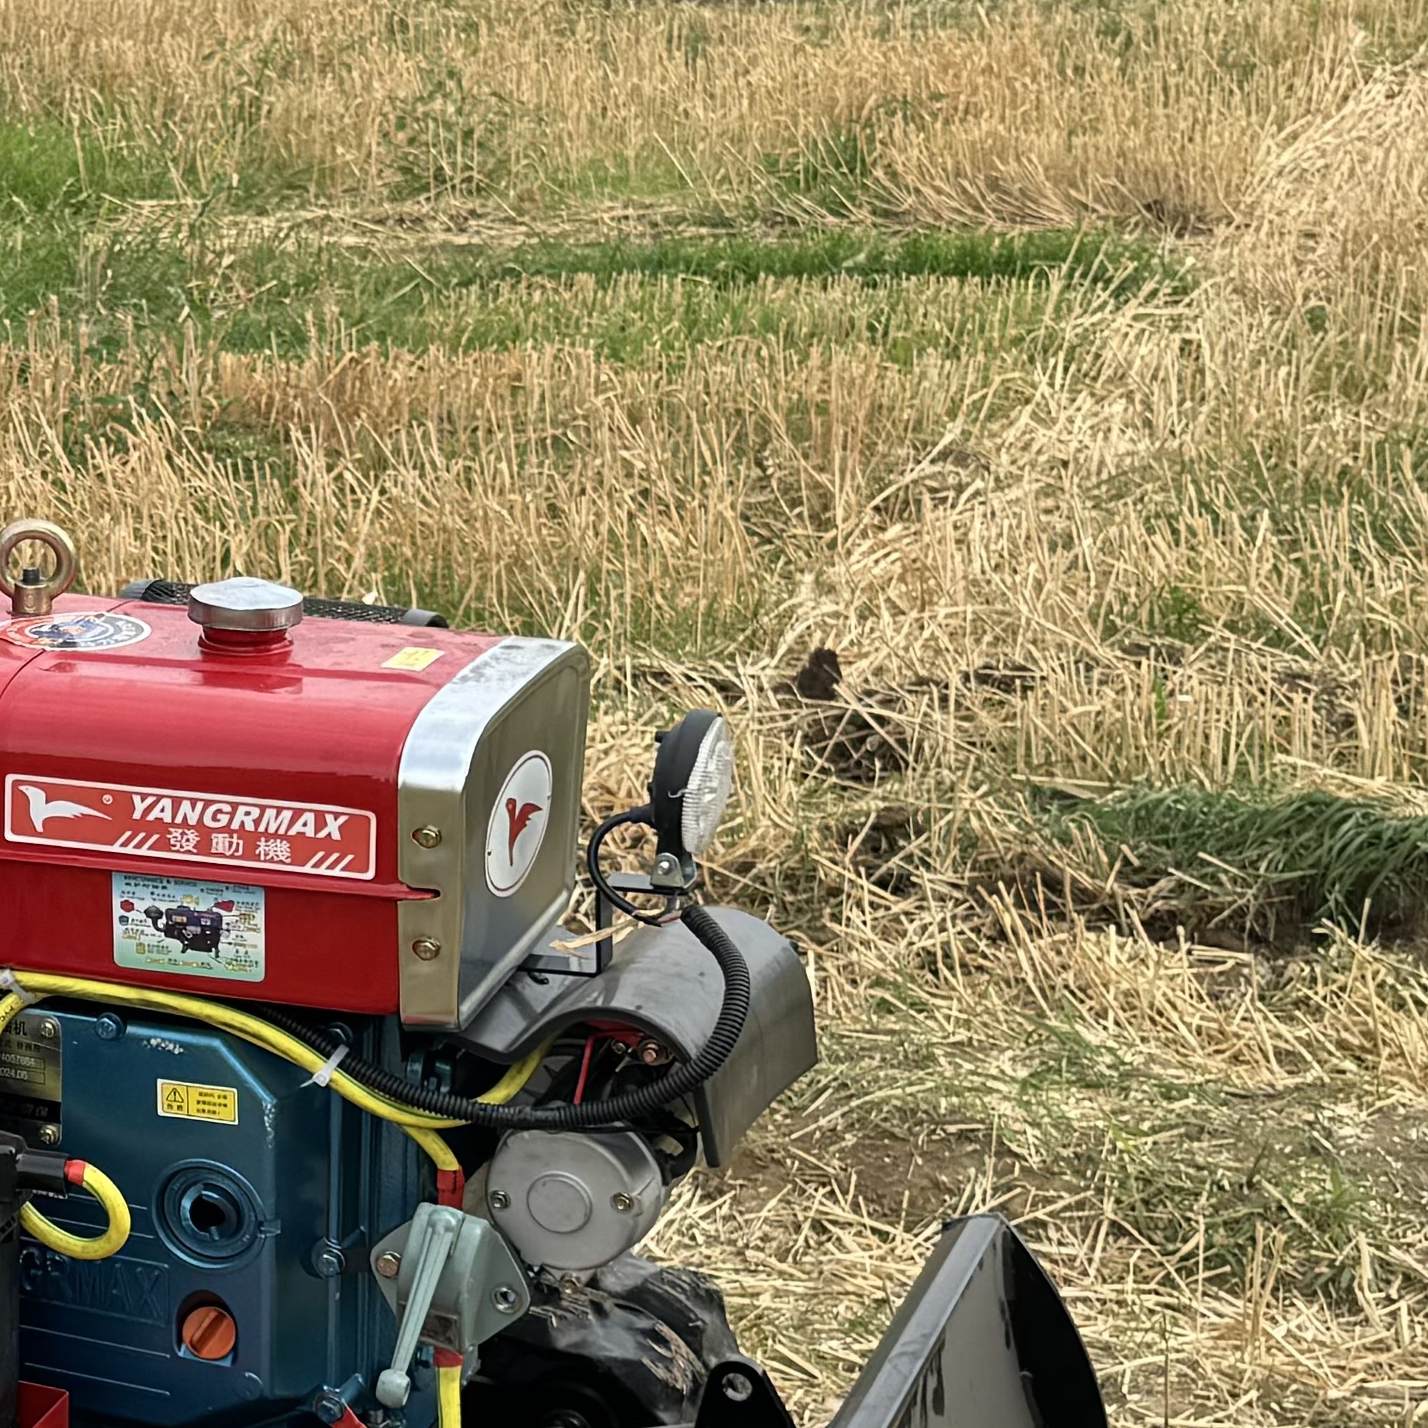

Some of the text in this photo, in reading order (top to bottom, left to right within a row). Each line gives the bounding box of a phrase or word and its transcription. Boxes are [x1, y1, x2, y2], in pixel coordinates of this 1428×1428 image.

[131, 795, 349, 841] YANGRMAX
[167, 828, 292, 864] 發動機
